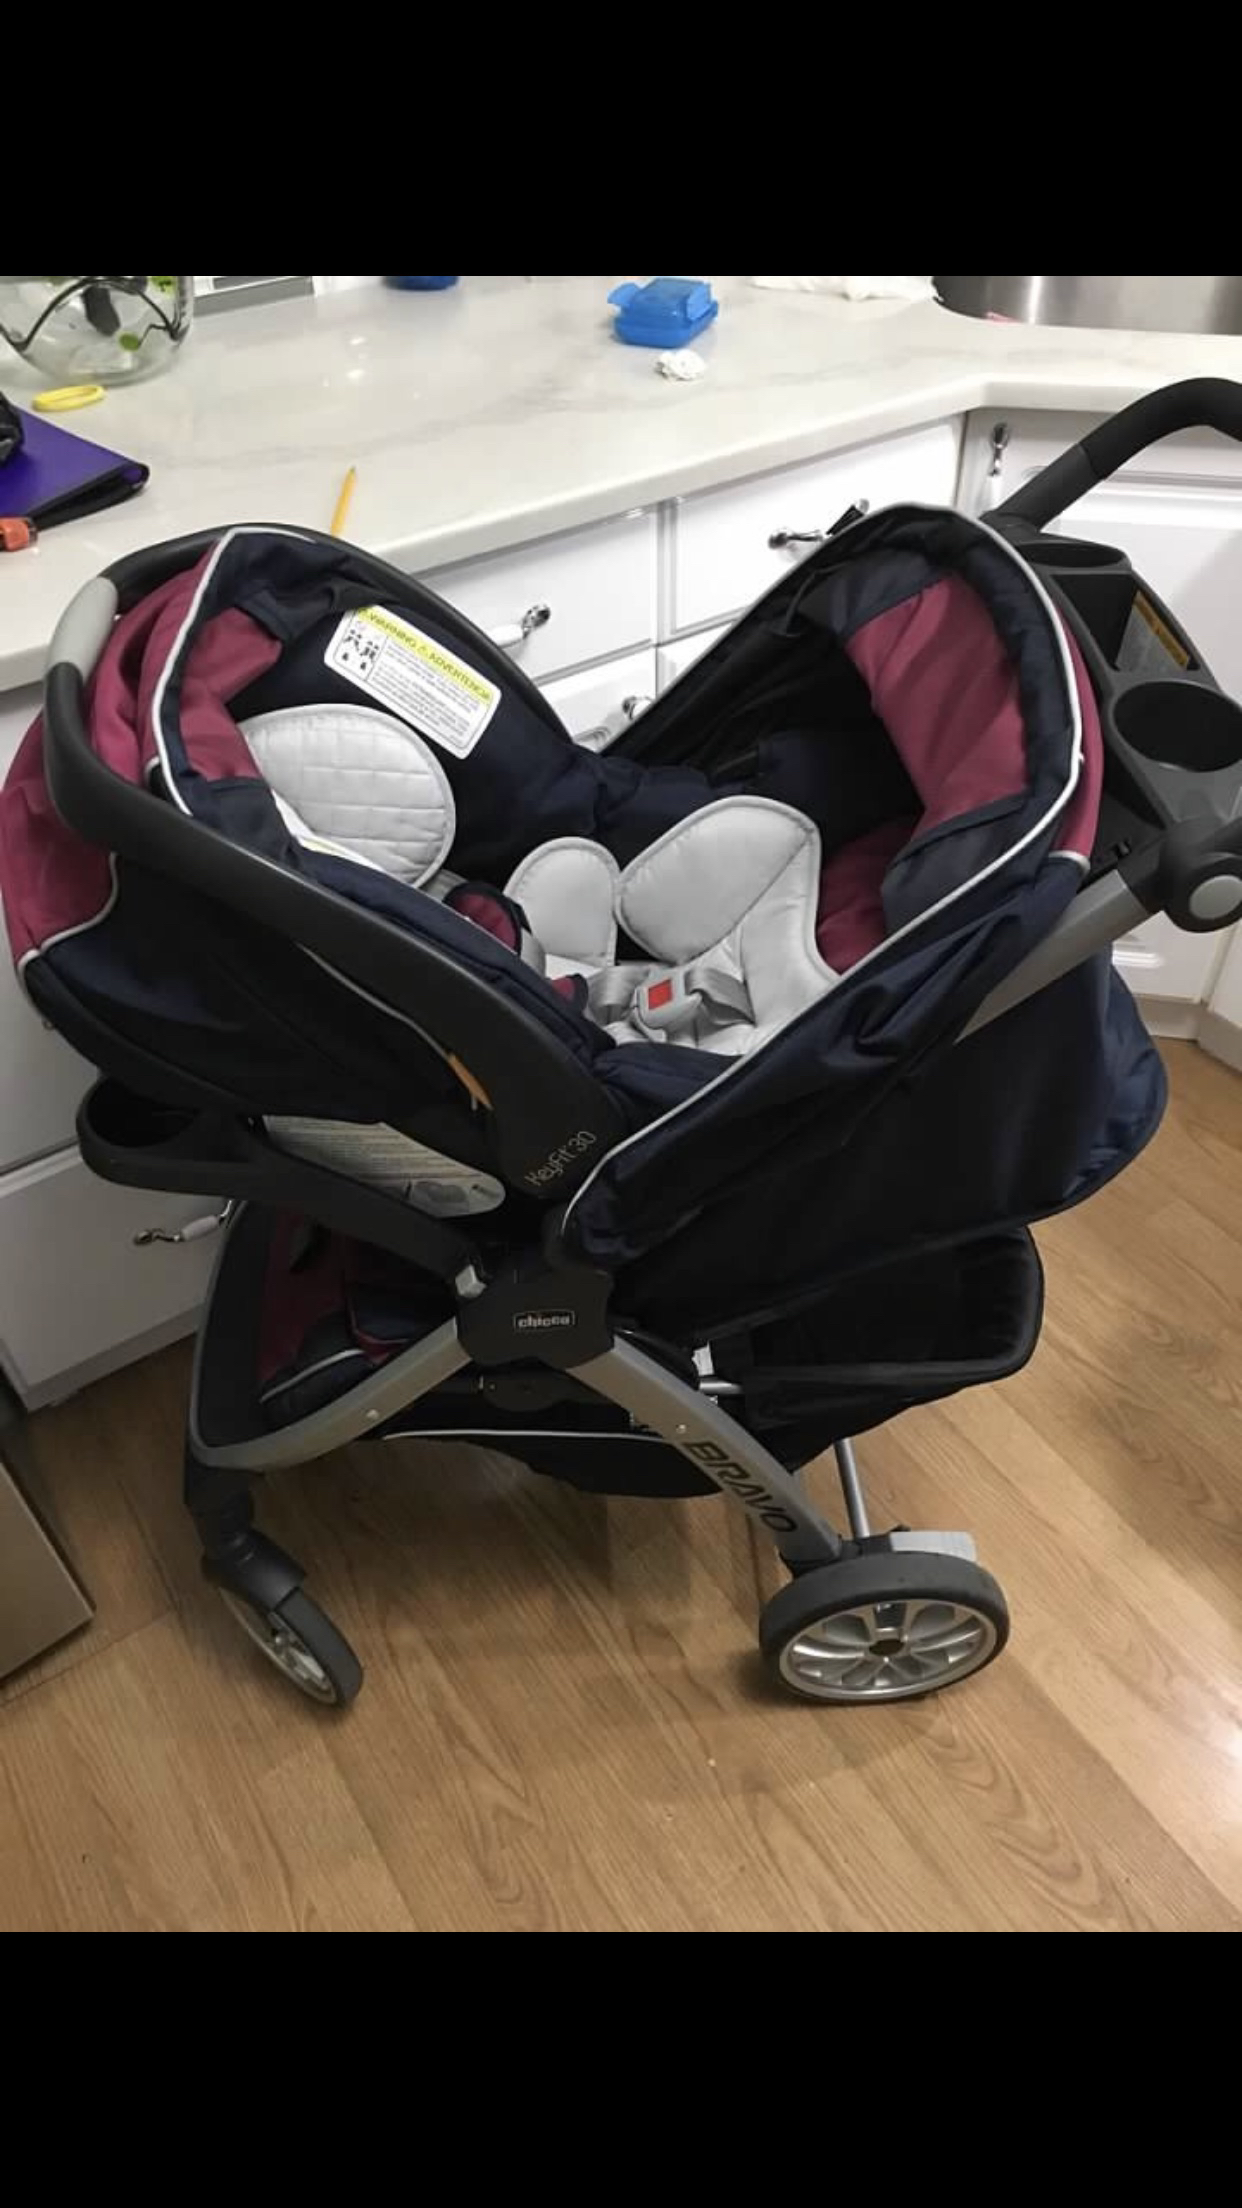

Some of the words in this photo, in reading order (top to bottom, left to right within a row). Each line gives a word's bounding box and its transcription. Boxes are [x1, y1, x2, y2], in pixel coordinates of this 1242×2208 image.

[369, 611, 417, 649] WARNING
[524, 1145, 577, 1186] KeyFit
[568, 1131, 597, 1151] 30
[518, 1314, 570, 1328] chicco
[681, 1441, 798, 1533] BRAVO
